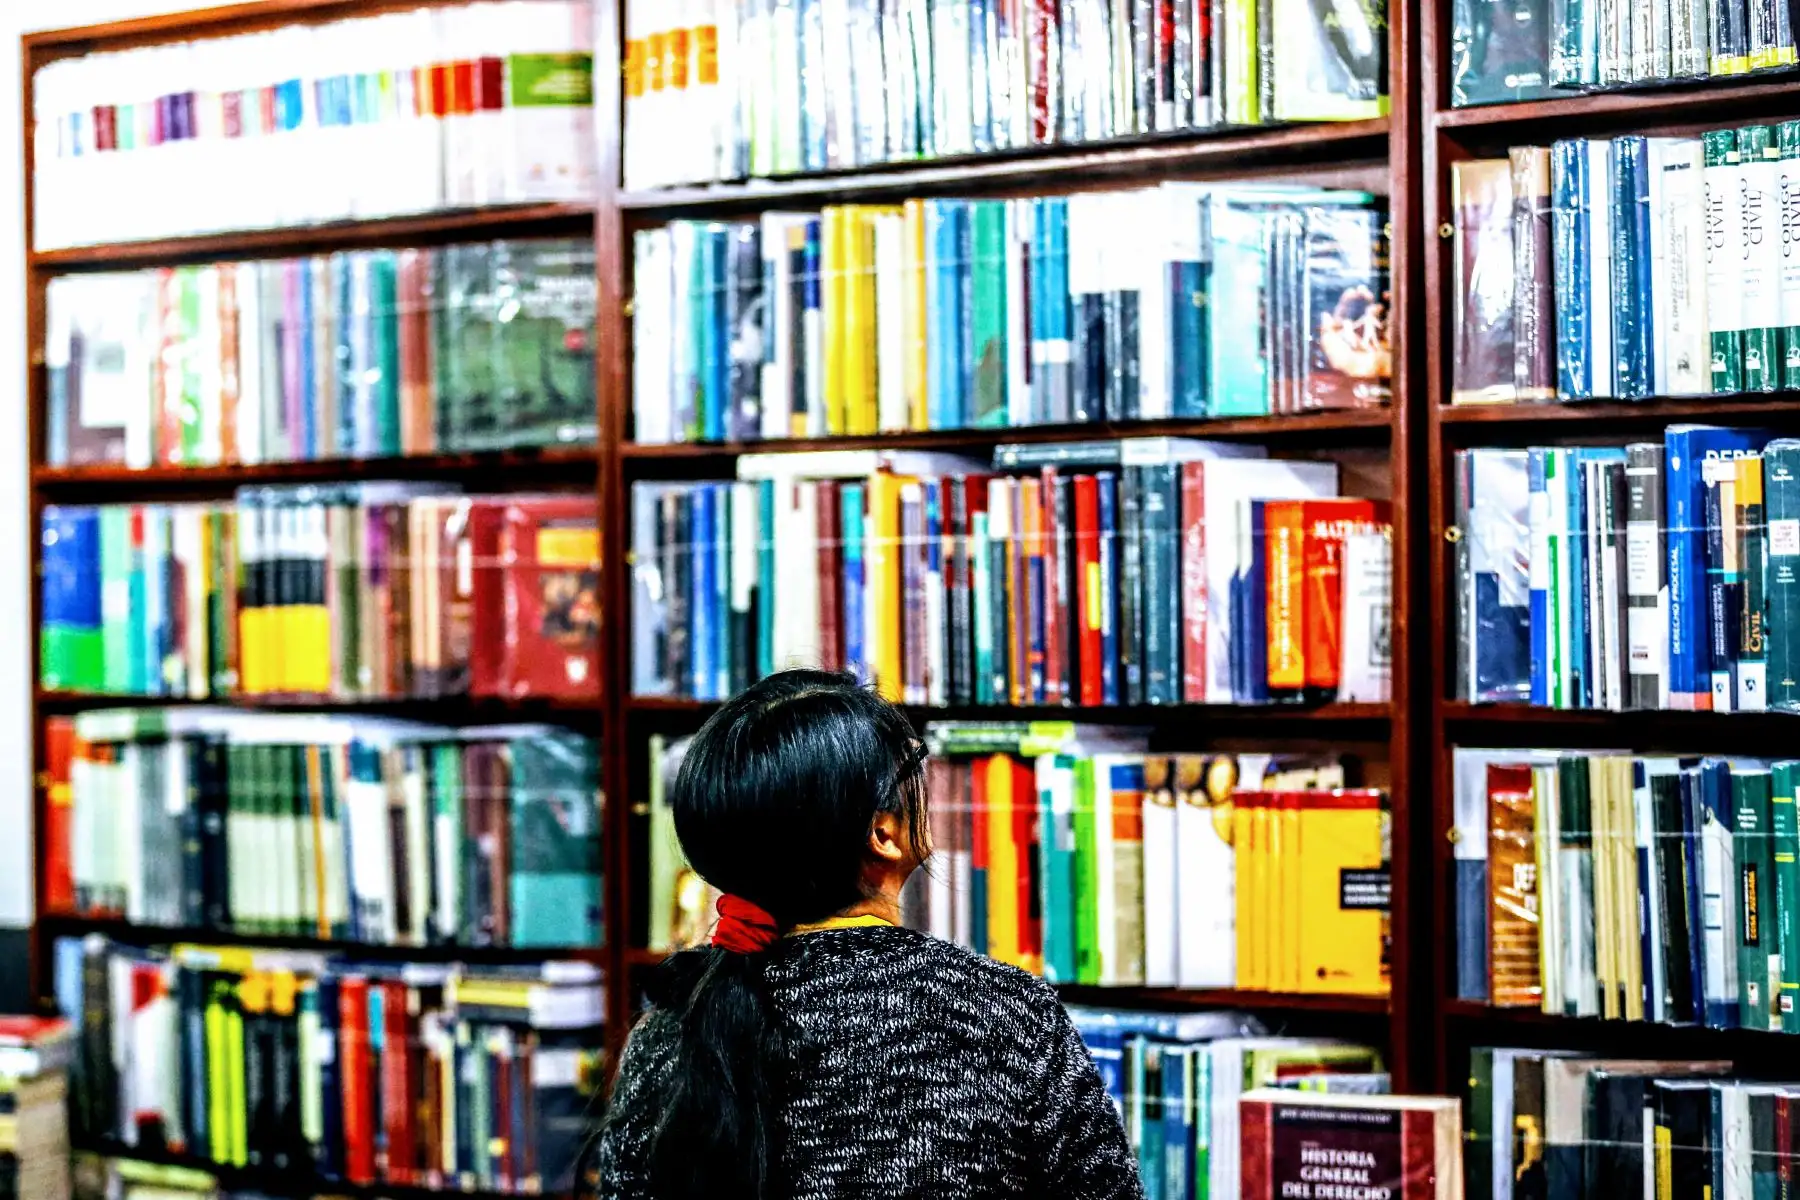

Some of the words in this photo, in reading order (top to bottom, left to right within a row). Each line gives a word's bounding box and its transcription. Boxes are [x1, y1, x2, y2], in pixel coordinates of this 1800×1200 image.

[1712, 195, 1725, 249] CIVIL
[1749, 190, 1762, 244] CIVIL
[1790, 188, 1800, 241] CIVIL
[1670, 547, 1680, 602] PROCESAL
[1671, 603, 1681, 655] DERECHO
[1749, 610, 1762, 653] CIVIL
[1300, 1166, 1370, 1184] GENERAL
[1301, 1149, 1376, 1168] HISTORIA
[1282, 1181, 1312, 1198] DEL
[1315, 1183, 1392, 1200] DERECHO
